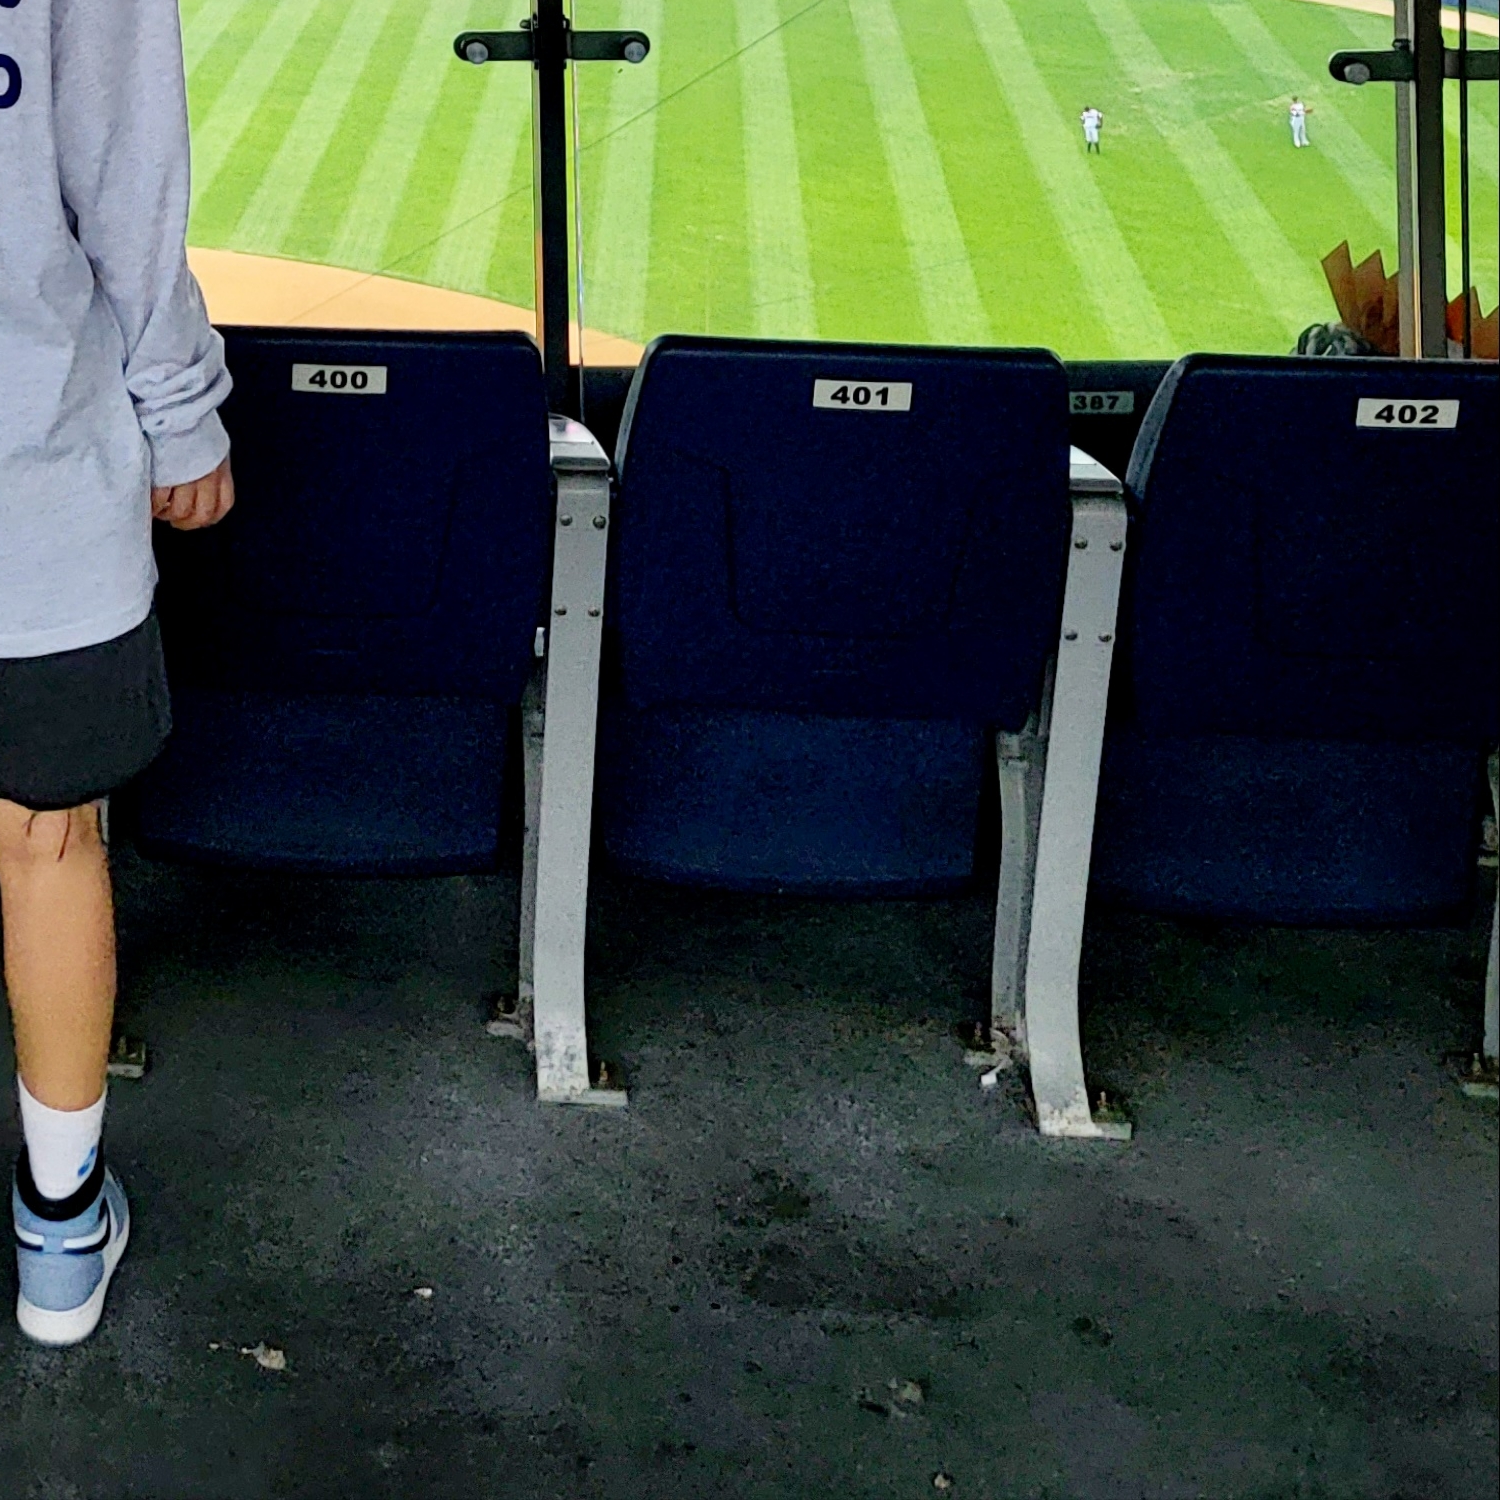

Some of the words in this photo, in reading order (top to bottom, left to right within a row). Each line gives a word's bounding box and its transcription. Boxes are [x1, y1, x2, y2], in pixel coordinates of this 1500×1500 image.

[308, 369, 368, 390] 400
[830, 385, 890, 407] 401
[1073, 394, 1120, 411] 387
[1375, 404, 1440, 425] 402
